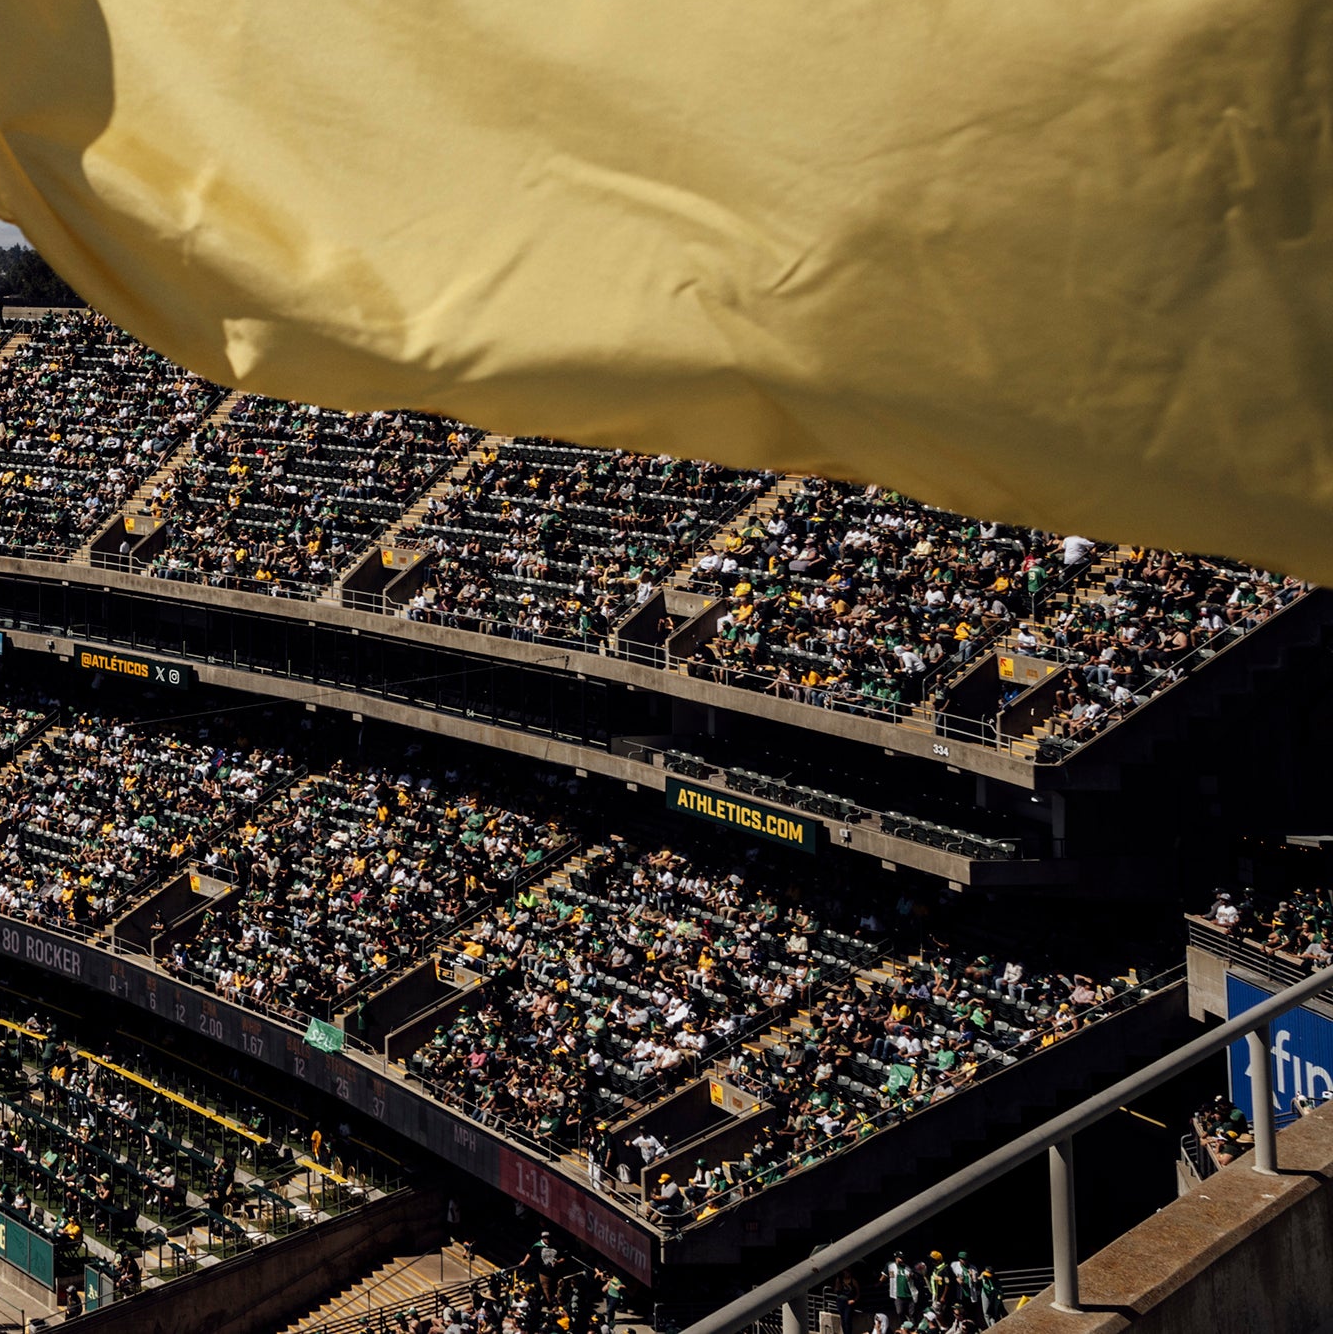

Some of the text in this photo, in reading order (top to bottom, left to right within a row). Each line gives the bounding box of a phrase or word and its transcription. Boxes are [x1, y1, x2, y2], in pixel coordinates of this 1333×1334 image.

[81, 651, 149, 678] @ATLÉTICOS
[933, 744, 949, 757] 334
[677, 788, 803, 844] ATHLETICS.COM
[2, 927, 20, 954] 80
[25, 935, 81, 977] ROCKER
[109, 974, 386, 1119] 0-1 6 12 2.00 1.67 12 25 37
[454, 1124, 476, 1154] MPH
[515, 1162, 550, 1207] 1:19
